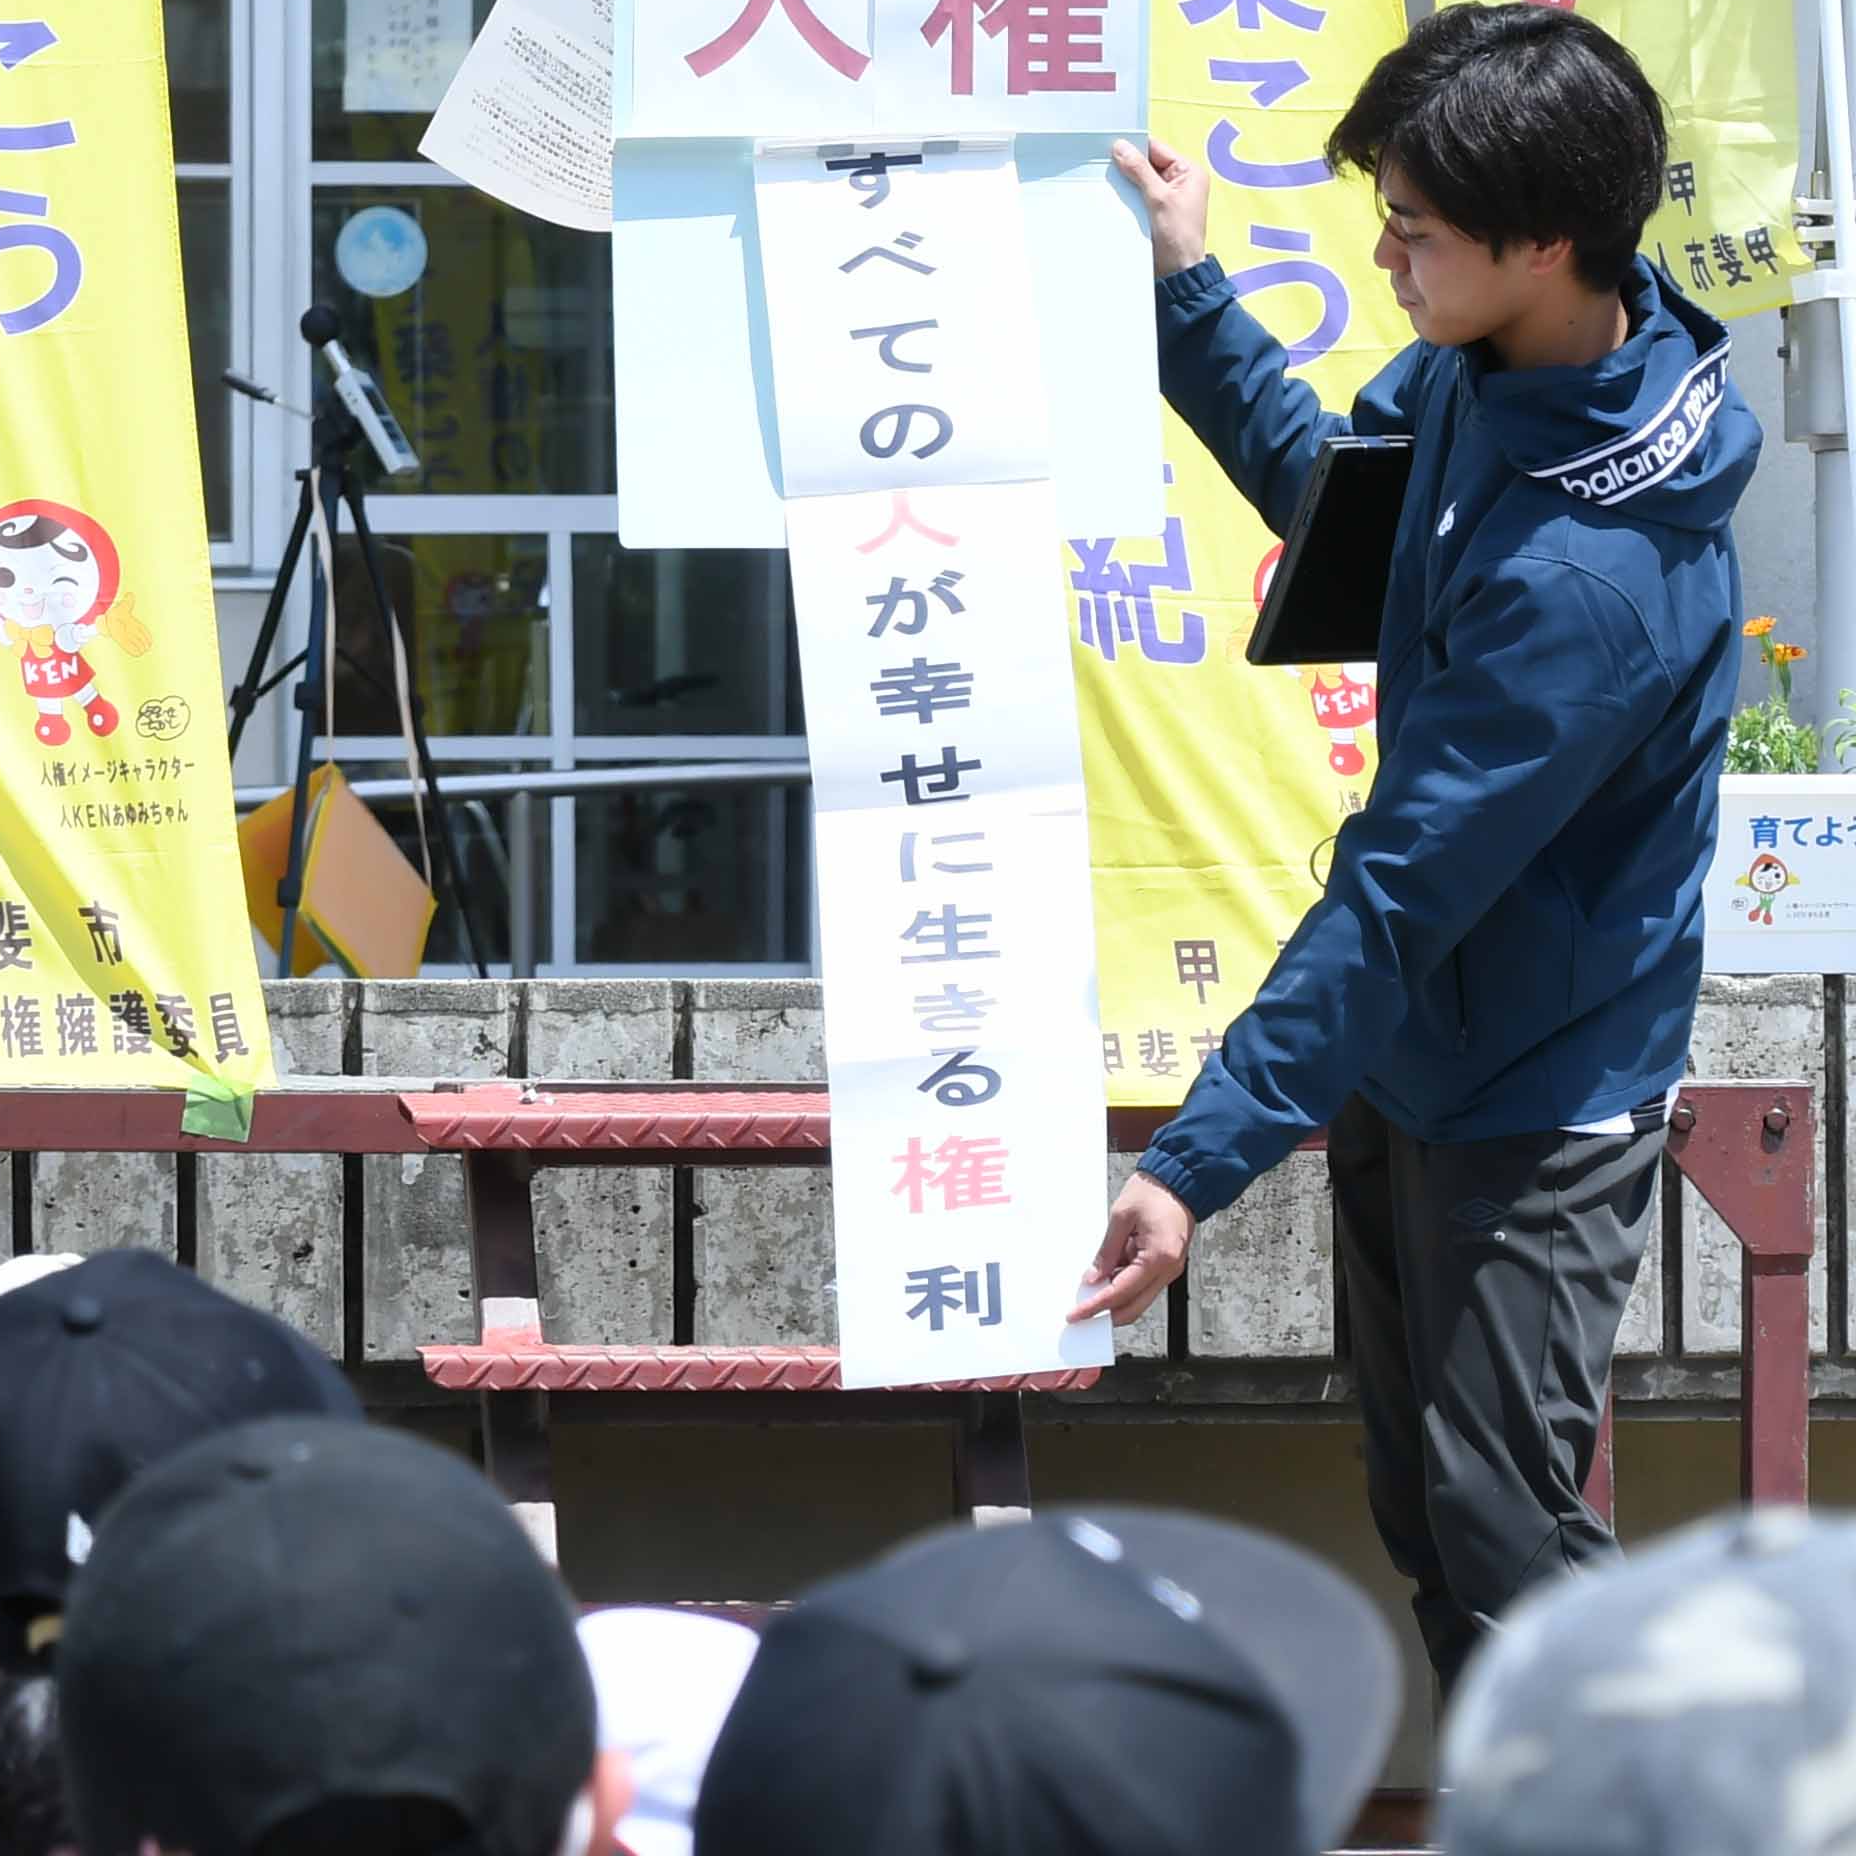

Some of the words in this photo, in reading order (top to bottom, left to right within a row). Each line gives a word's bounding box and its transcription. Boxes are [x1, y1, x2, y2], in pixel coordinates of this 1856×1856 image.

[1560, 419, 1687, 499] balance
[23, 655, 80, 685] KEN
[1314, 686, 1370, 716] KEN
[825, 151, 1012, 1332] すべての人が幸せに生きる権利
[41, 756, 196, 788] 人権イメージキャラクター
[60, 799, 189, 830] 人KENあゆみちゃん
